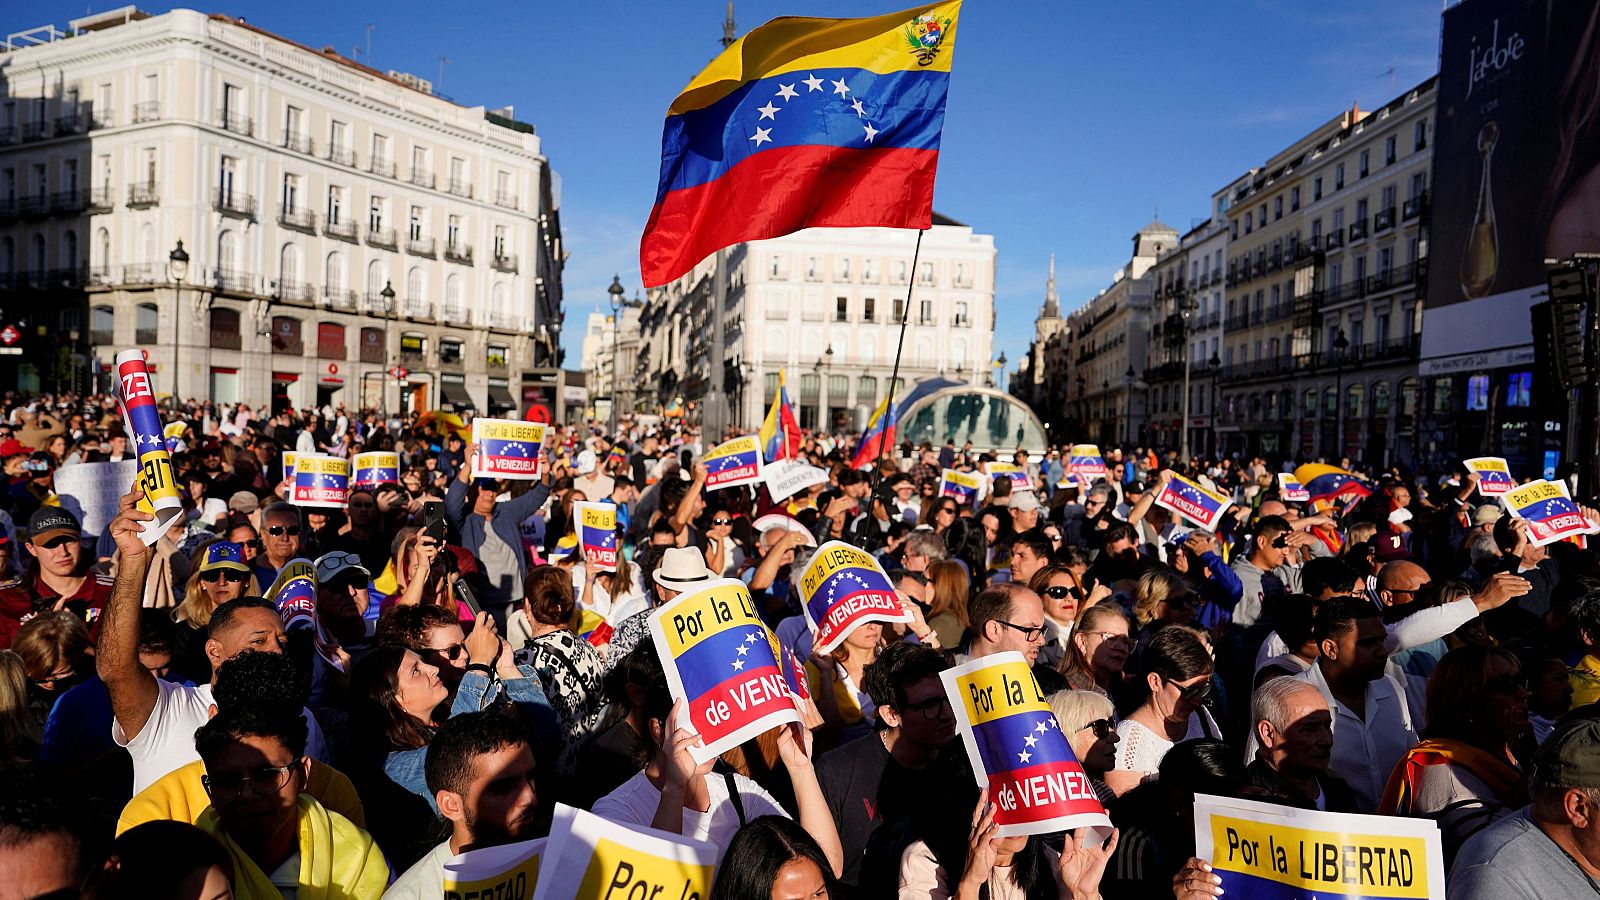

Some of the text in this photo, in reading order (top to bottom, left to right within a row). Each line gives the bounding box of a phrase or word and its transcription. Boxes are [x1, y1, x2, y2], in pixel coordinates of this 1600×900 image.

[496, 458, 535, 471] VENEZUELA
[1174, 495, 1209, 521] VENEZUELA
[1513, 493, 1531, 506] Por
[587, 511, 599, 525] Por
[602, 515, 610, 526] la
[804, 574, 817, 596] Por
[816, 564, 825, 580] la
[673, 608, 704, 645] Por
[709, 596, 733, 625] la
[828, 593, 896, 628] VENEZUELA
[968, 682, 995, 716] Por
[1001, 673, 1025, 707] la
[705, 699, 731, 727] de
[998, 783, 1017, 812] de
[1226, 827, 1414, 888] Por la LIBERTAD
